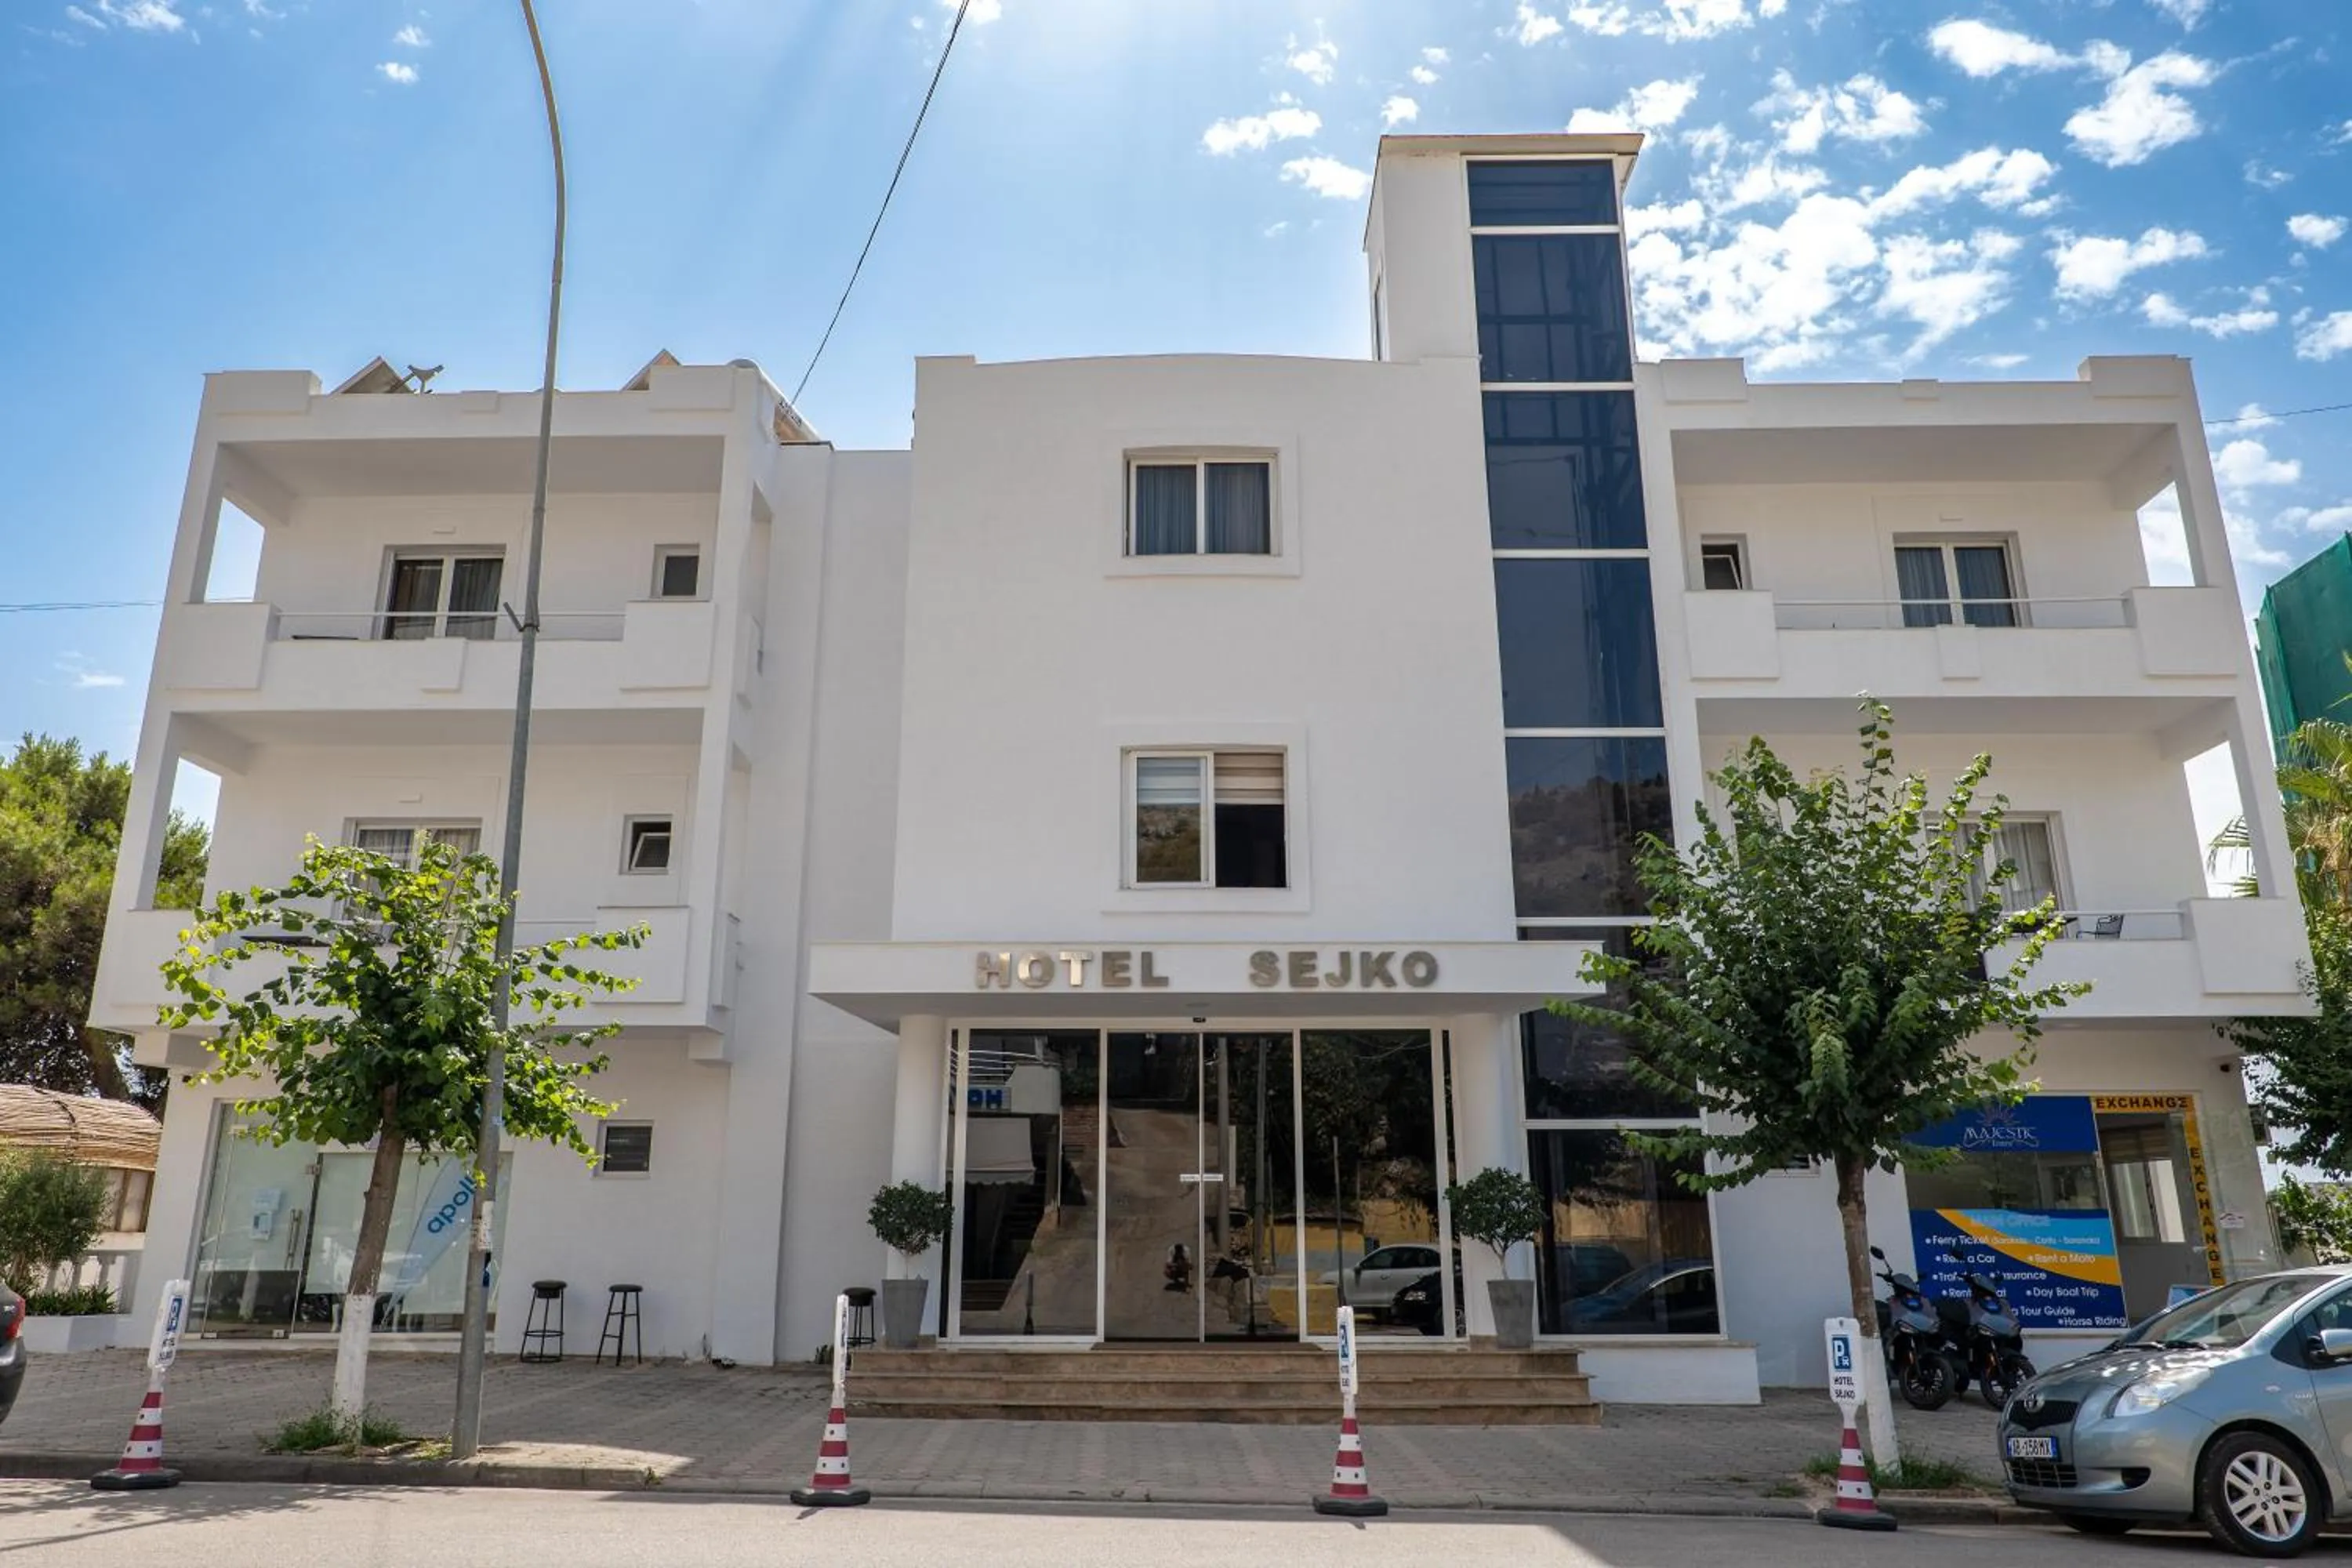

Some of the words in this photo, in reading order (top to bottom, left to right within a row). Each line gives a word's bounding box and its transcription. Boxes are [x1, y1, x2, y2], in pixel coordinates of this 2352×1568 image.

[976, 951, 1169, 988] HOTEL
[1250, 950, 1438, 987] SEJKO
[1963, 1127, 2037, 1142] MAJESTIC
[2190, 1148, 2221, 1279] EXCHANGE
[1933, 1236, 1957, 1247] Ferry
[1959, 1236, 1989, 1244] Ticket
[1977, 1254, 1995, 1264] Car
[2033, 1287, 2053, 1298] Day
[2056, 1287, 2079, 1297] Boat
[2081, 1287, 2100, 1298] Trip
[2020, 1306, 2041, 1316] Tour
[2044, 1305, 2075, 1316] Guide
[2064, 1317, 2092, 1327] Horse
[2095, 1316, 2126, 1327] Riding
[1833, 1340, 1845, 1367] P
[1835, 1376, 1854, 1385] HOTEL
